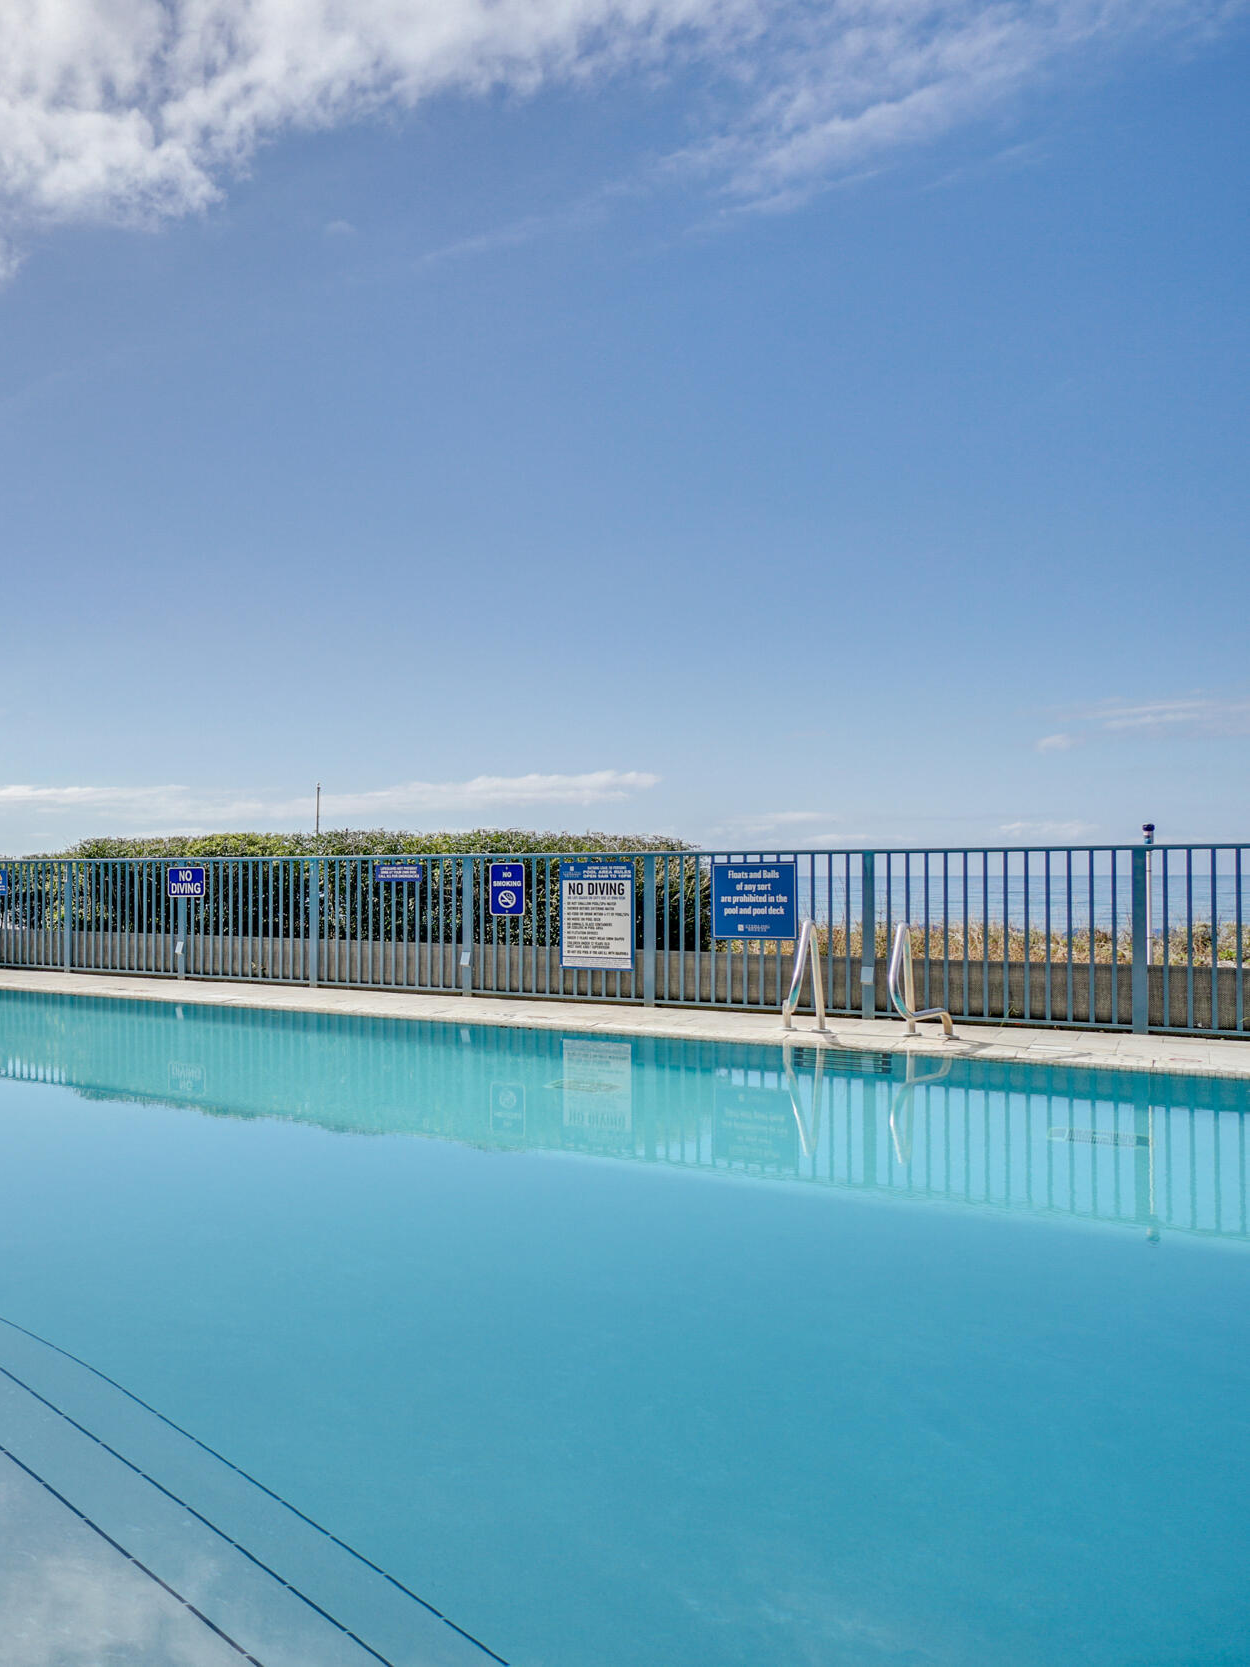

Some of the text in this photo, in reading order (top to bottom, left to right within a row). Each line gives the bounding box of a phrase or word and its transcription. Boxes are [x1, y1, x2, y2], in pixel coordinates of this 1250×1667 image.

[179, 870, 192, 881] NO
[728, 870, 779, 878] Floats and Balls
[171, 883, 201, 894] DIVING
[568, 883, 624, 895] NO DIVING
[736, 882, 743, 890] of
[744, 884, 756, 892] any
[732, 894, 767, 904] prohibited
[768, 894, 774, 902] in
[776, 894, 788, 902] the
[724, 906, 784, 916] pool and pool deck
